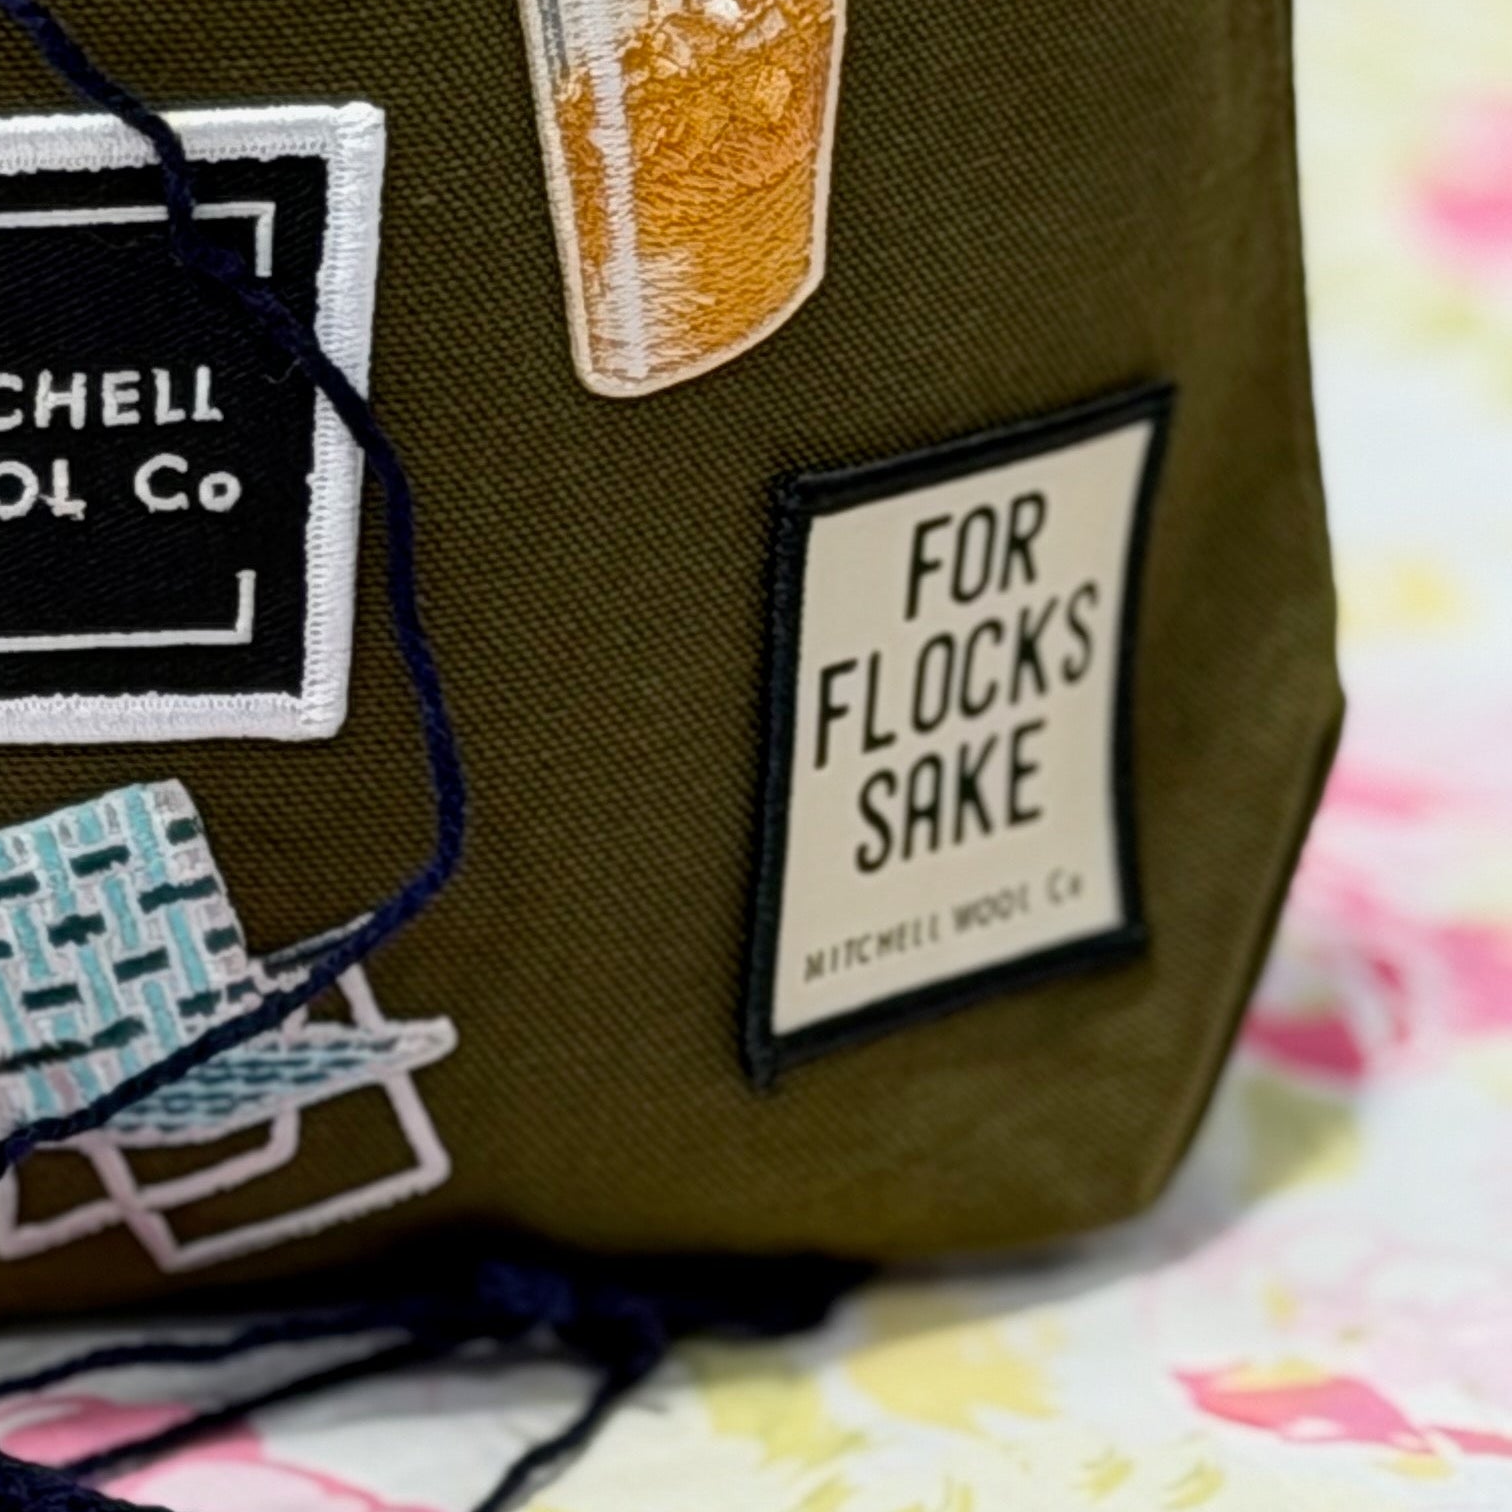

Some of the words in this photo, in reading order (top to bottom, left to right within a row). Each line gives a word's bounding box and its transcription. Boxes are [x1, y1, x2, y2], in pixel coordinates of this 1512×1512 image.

[134, 452, 242, 513] Co
[904, 490, 1047, 621] FOR
[814, 581, 1099, 770] FLOCKS
[855, 719, 1047, 874] SAKE
[804, 913, 940, 982] MITCHELL
[954, 883, 1031, 932] WOOL
